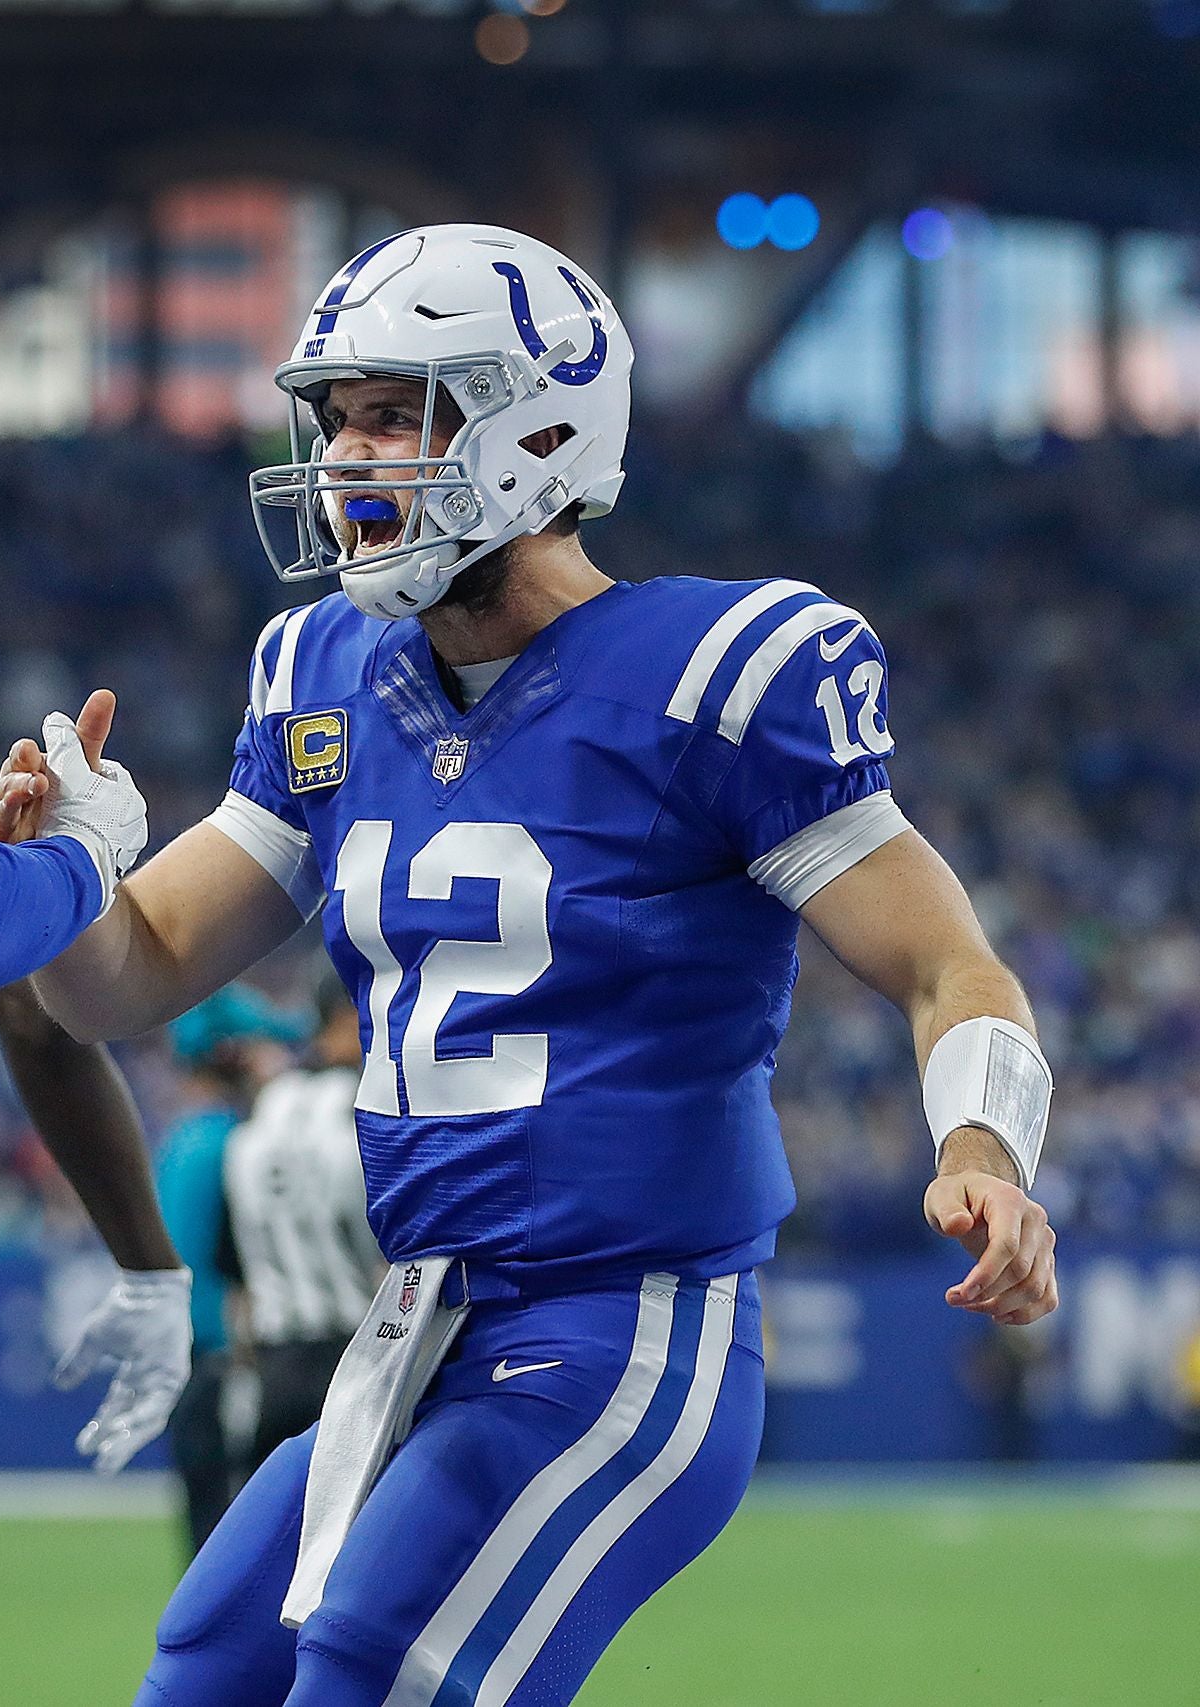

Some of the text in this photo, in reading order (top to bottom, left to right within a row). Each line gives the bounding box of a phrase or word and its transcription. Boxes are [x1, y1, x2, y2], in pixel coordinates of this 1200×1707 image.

[290, 716, 341, 770] C
[815, 660, 896, 768] 12
[333, 820, 553, 1117] 12
